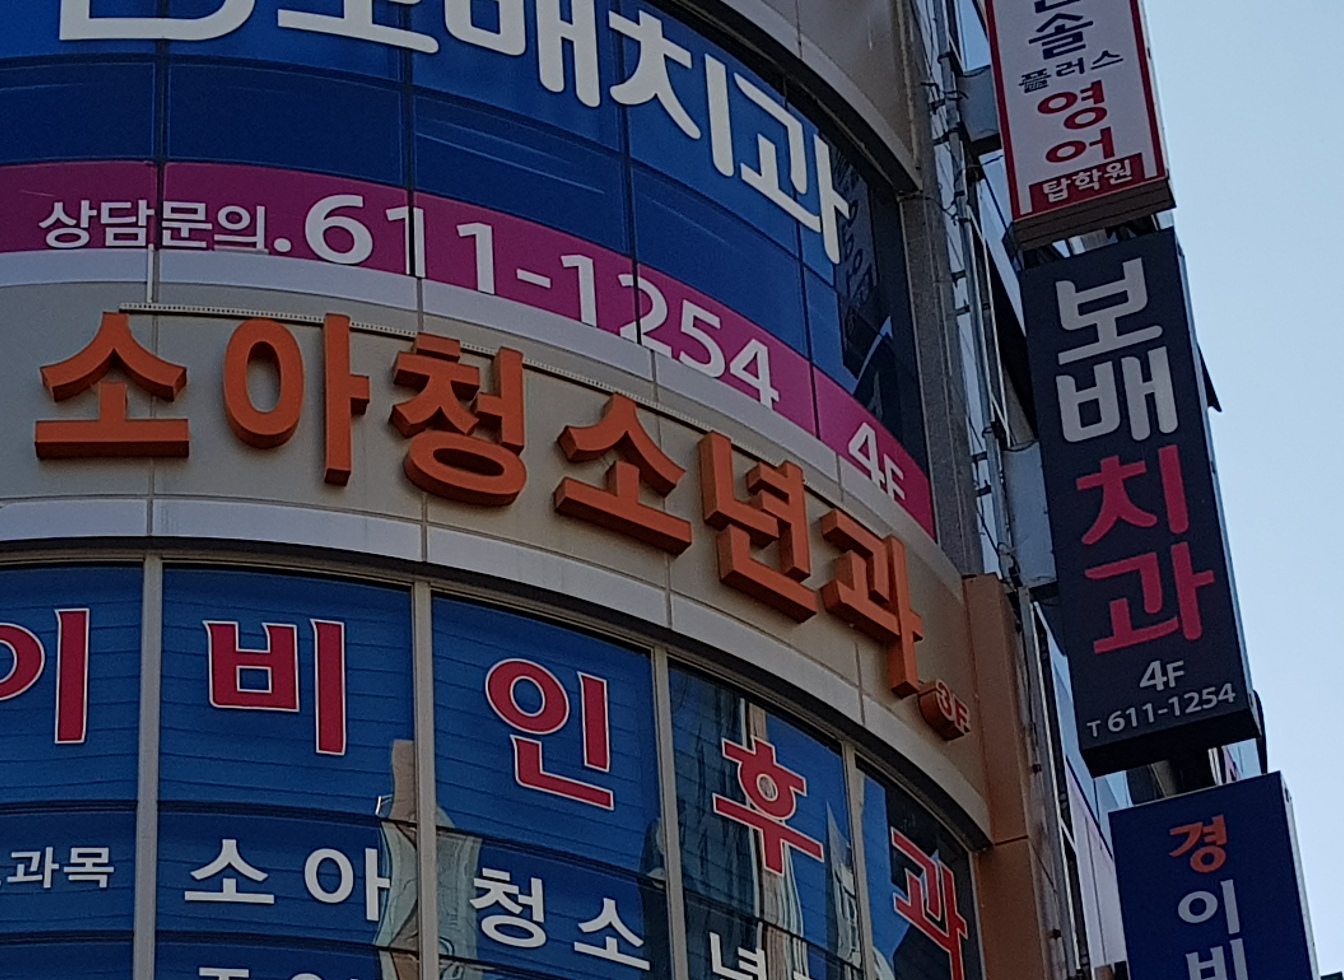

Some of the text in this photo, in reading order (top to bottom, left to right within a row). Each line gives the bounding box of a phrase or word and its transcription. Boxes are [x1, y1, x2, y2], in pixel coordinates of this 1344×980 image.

[1028, 0, 1094, 60] 솔
[1018, 49, 1125, 94] 플러스
[1037, 79, 1116, 164] 영어
[1042, 158, 1133, 203] 탑학원
[848, 421, 906, 500] 4F
[34, 311, 924, 698] 소아청소년과
[1139, 659, 1186, 692] 4F
